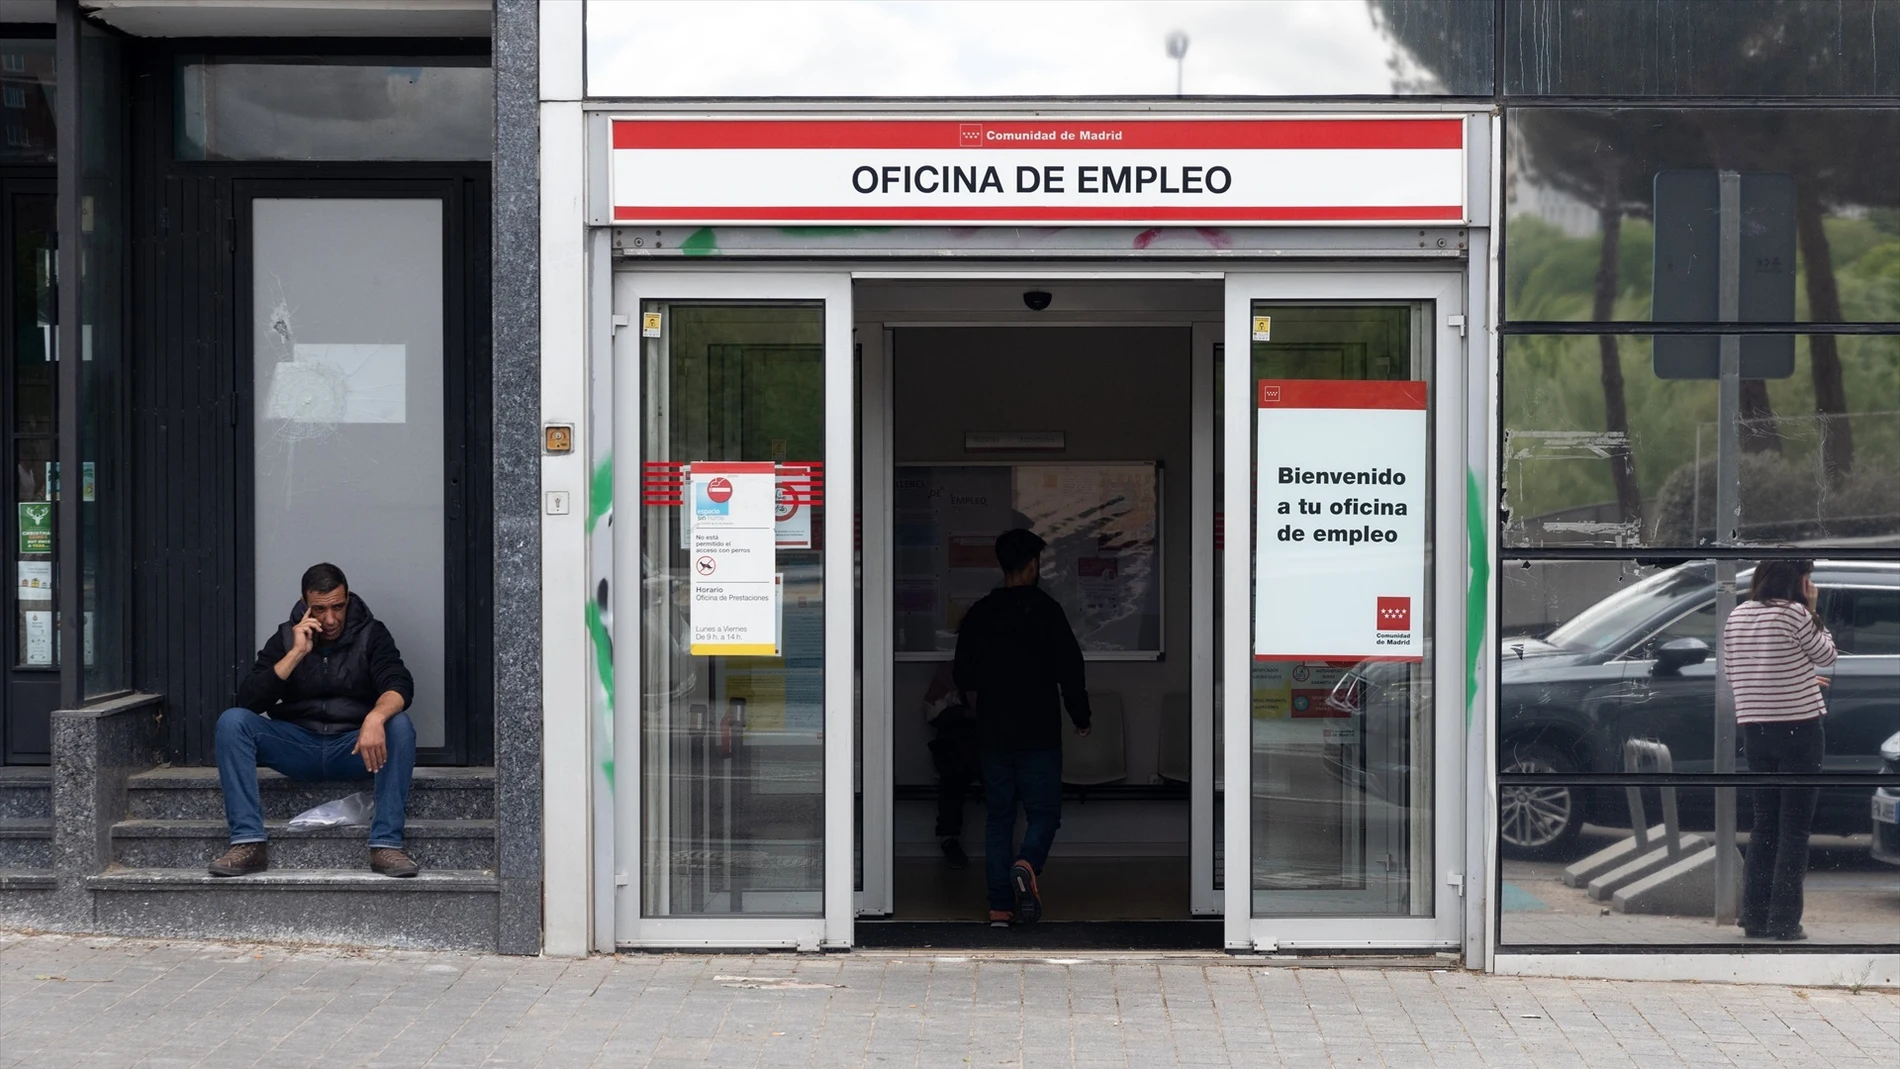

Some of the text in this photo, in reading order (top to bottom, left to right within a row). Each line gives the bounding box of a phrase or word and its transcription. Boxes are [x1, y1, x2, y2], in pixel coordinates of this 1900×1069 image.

[986, 129, 1123, 141] Comunidad de Madrid
[852, 165, 1232, 194] OFICINA DE EMPLEO
[1278, 467, 1406, 486] Bienvenido
[930, 490, 941, 498] DE
[951, 496, 987, 505] EMPLEO
[697, 508, 720, 516] espacio
[1277, 498, 1408, 516] a tu oficina
[1277, 525, 1398, 546] de empleo
